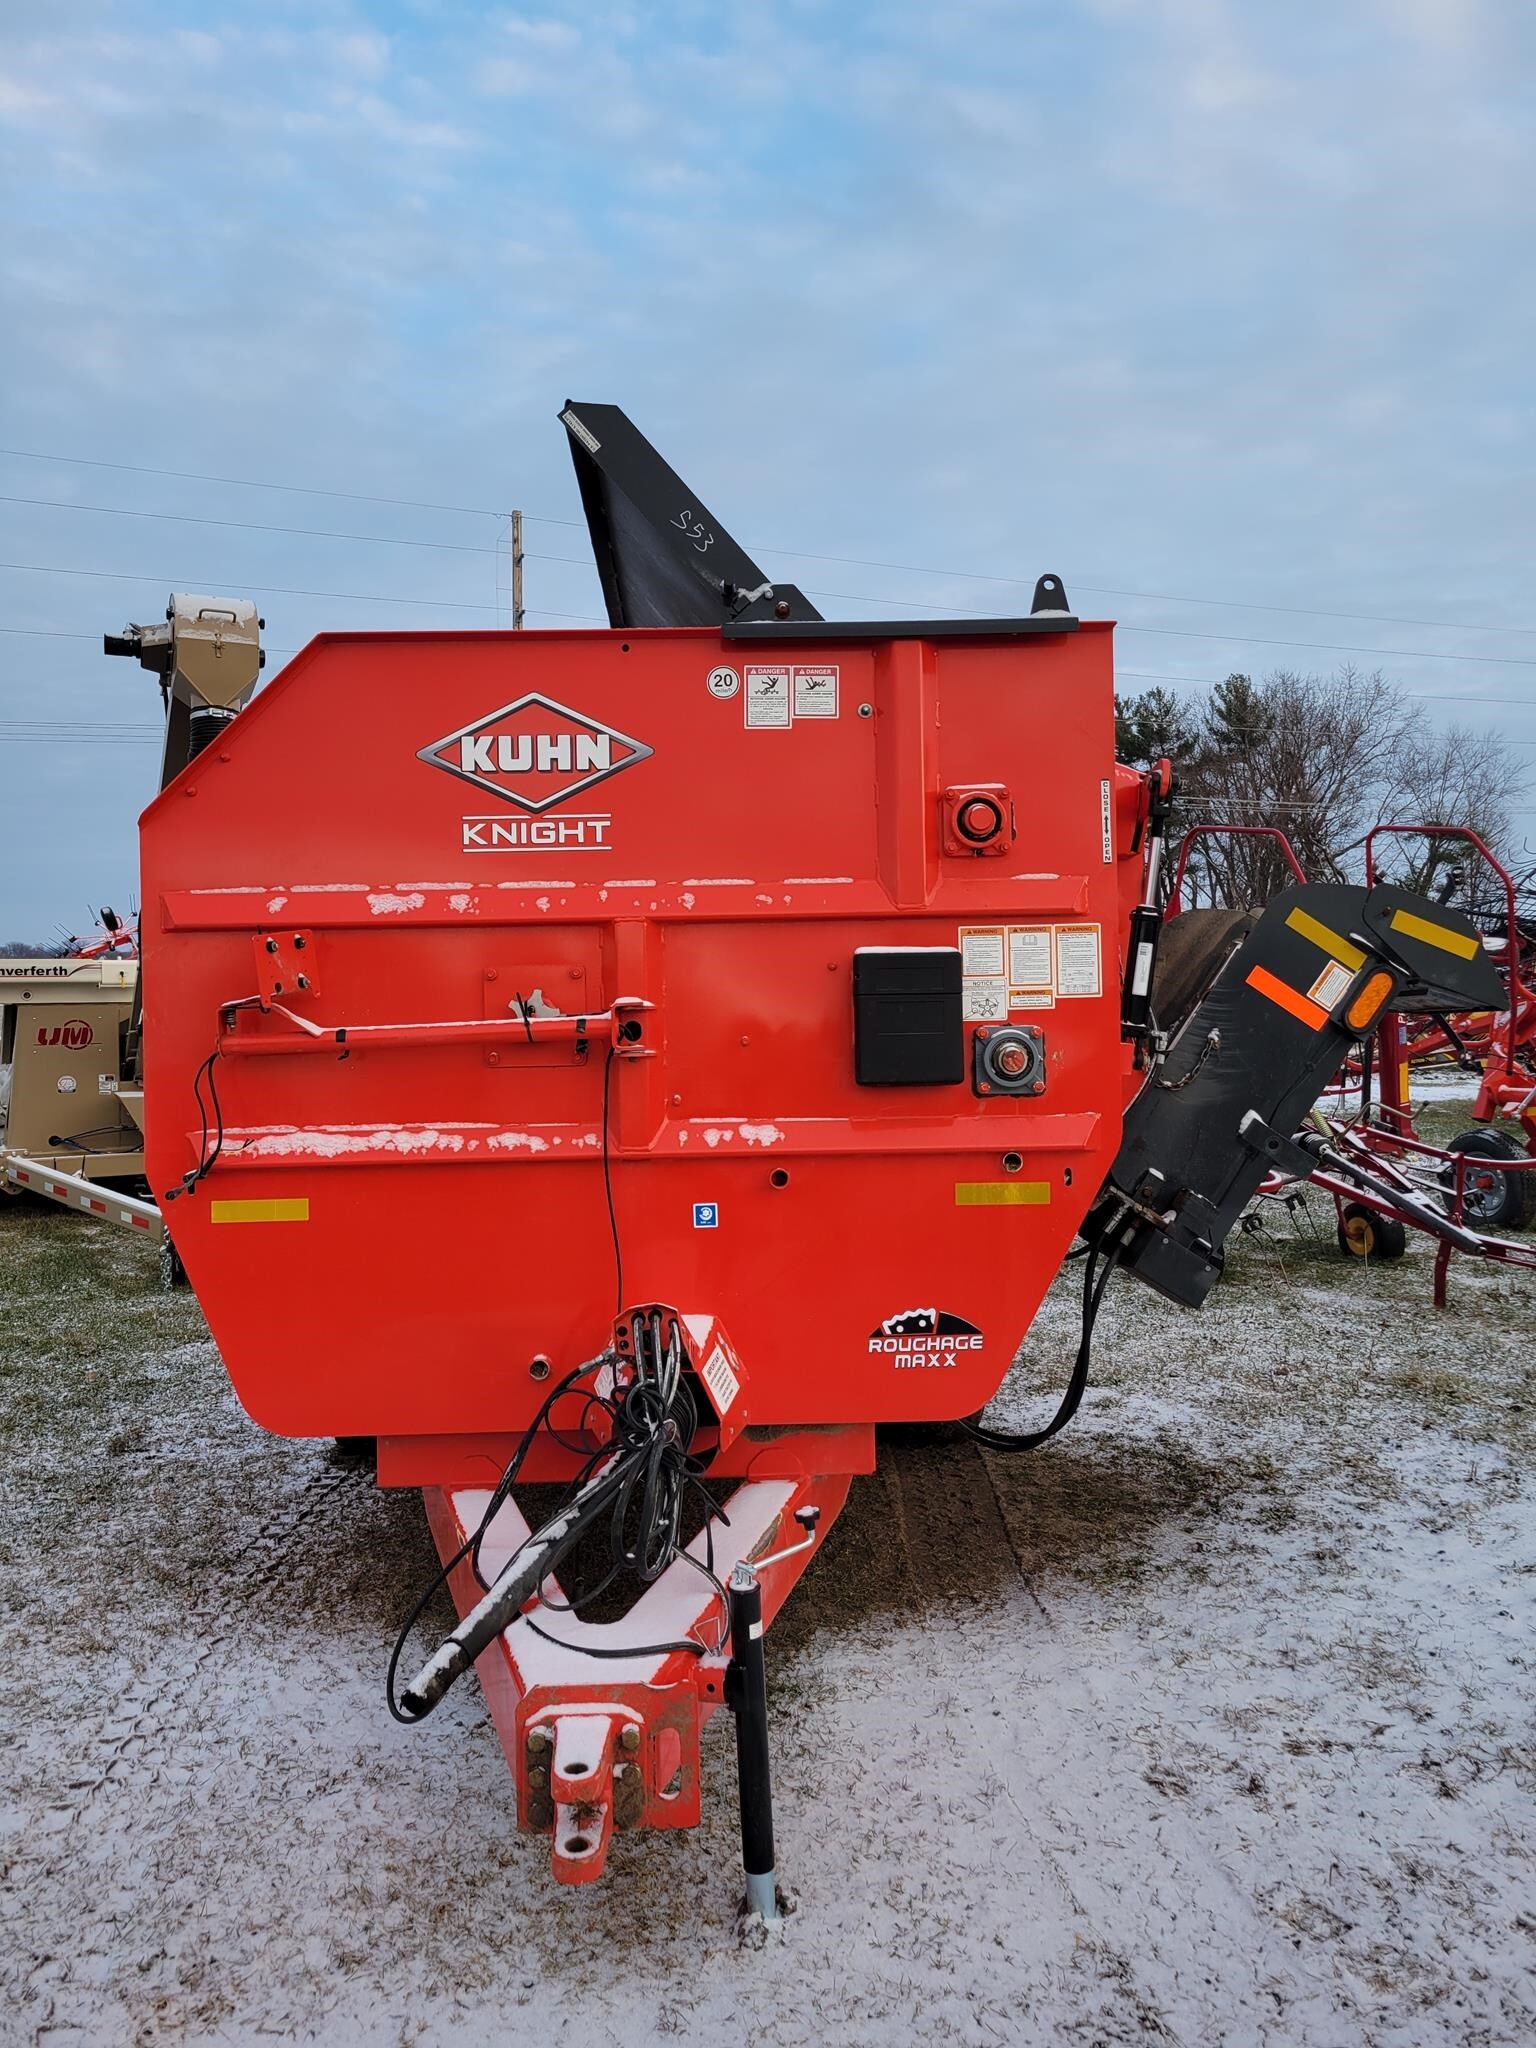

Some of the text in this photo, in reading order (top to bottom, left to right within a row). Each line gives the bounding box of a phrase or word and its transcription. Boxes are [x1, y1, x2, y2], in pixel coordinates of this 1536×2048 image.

[668, 510, 714, 552] S53
[757, 667, 786, 675] DANGER
[713, 673, 733, 688] 20
[460, 733, 611, 774] KUHN
[462, 820, 612, 845] KNIGHT
[868, 1335, 983, 1353] ROUGHAGE
[895, 1353, 957, 1368] MAXX
